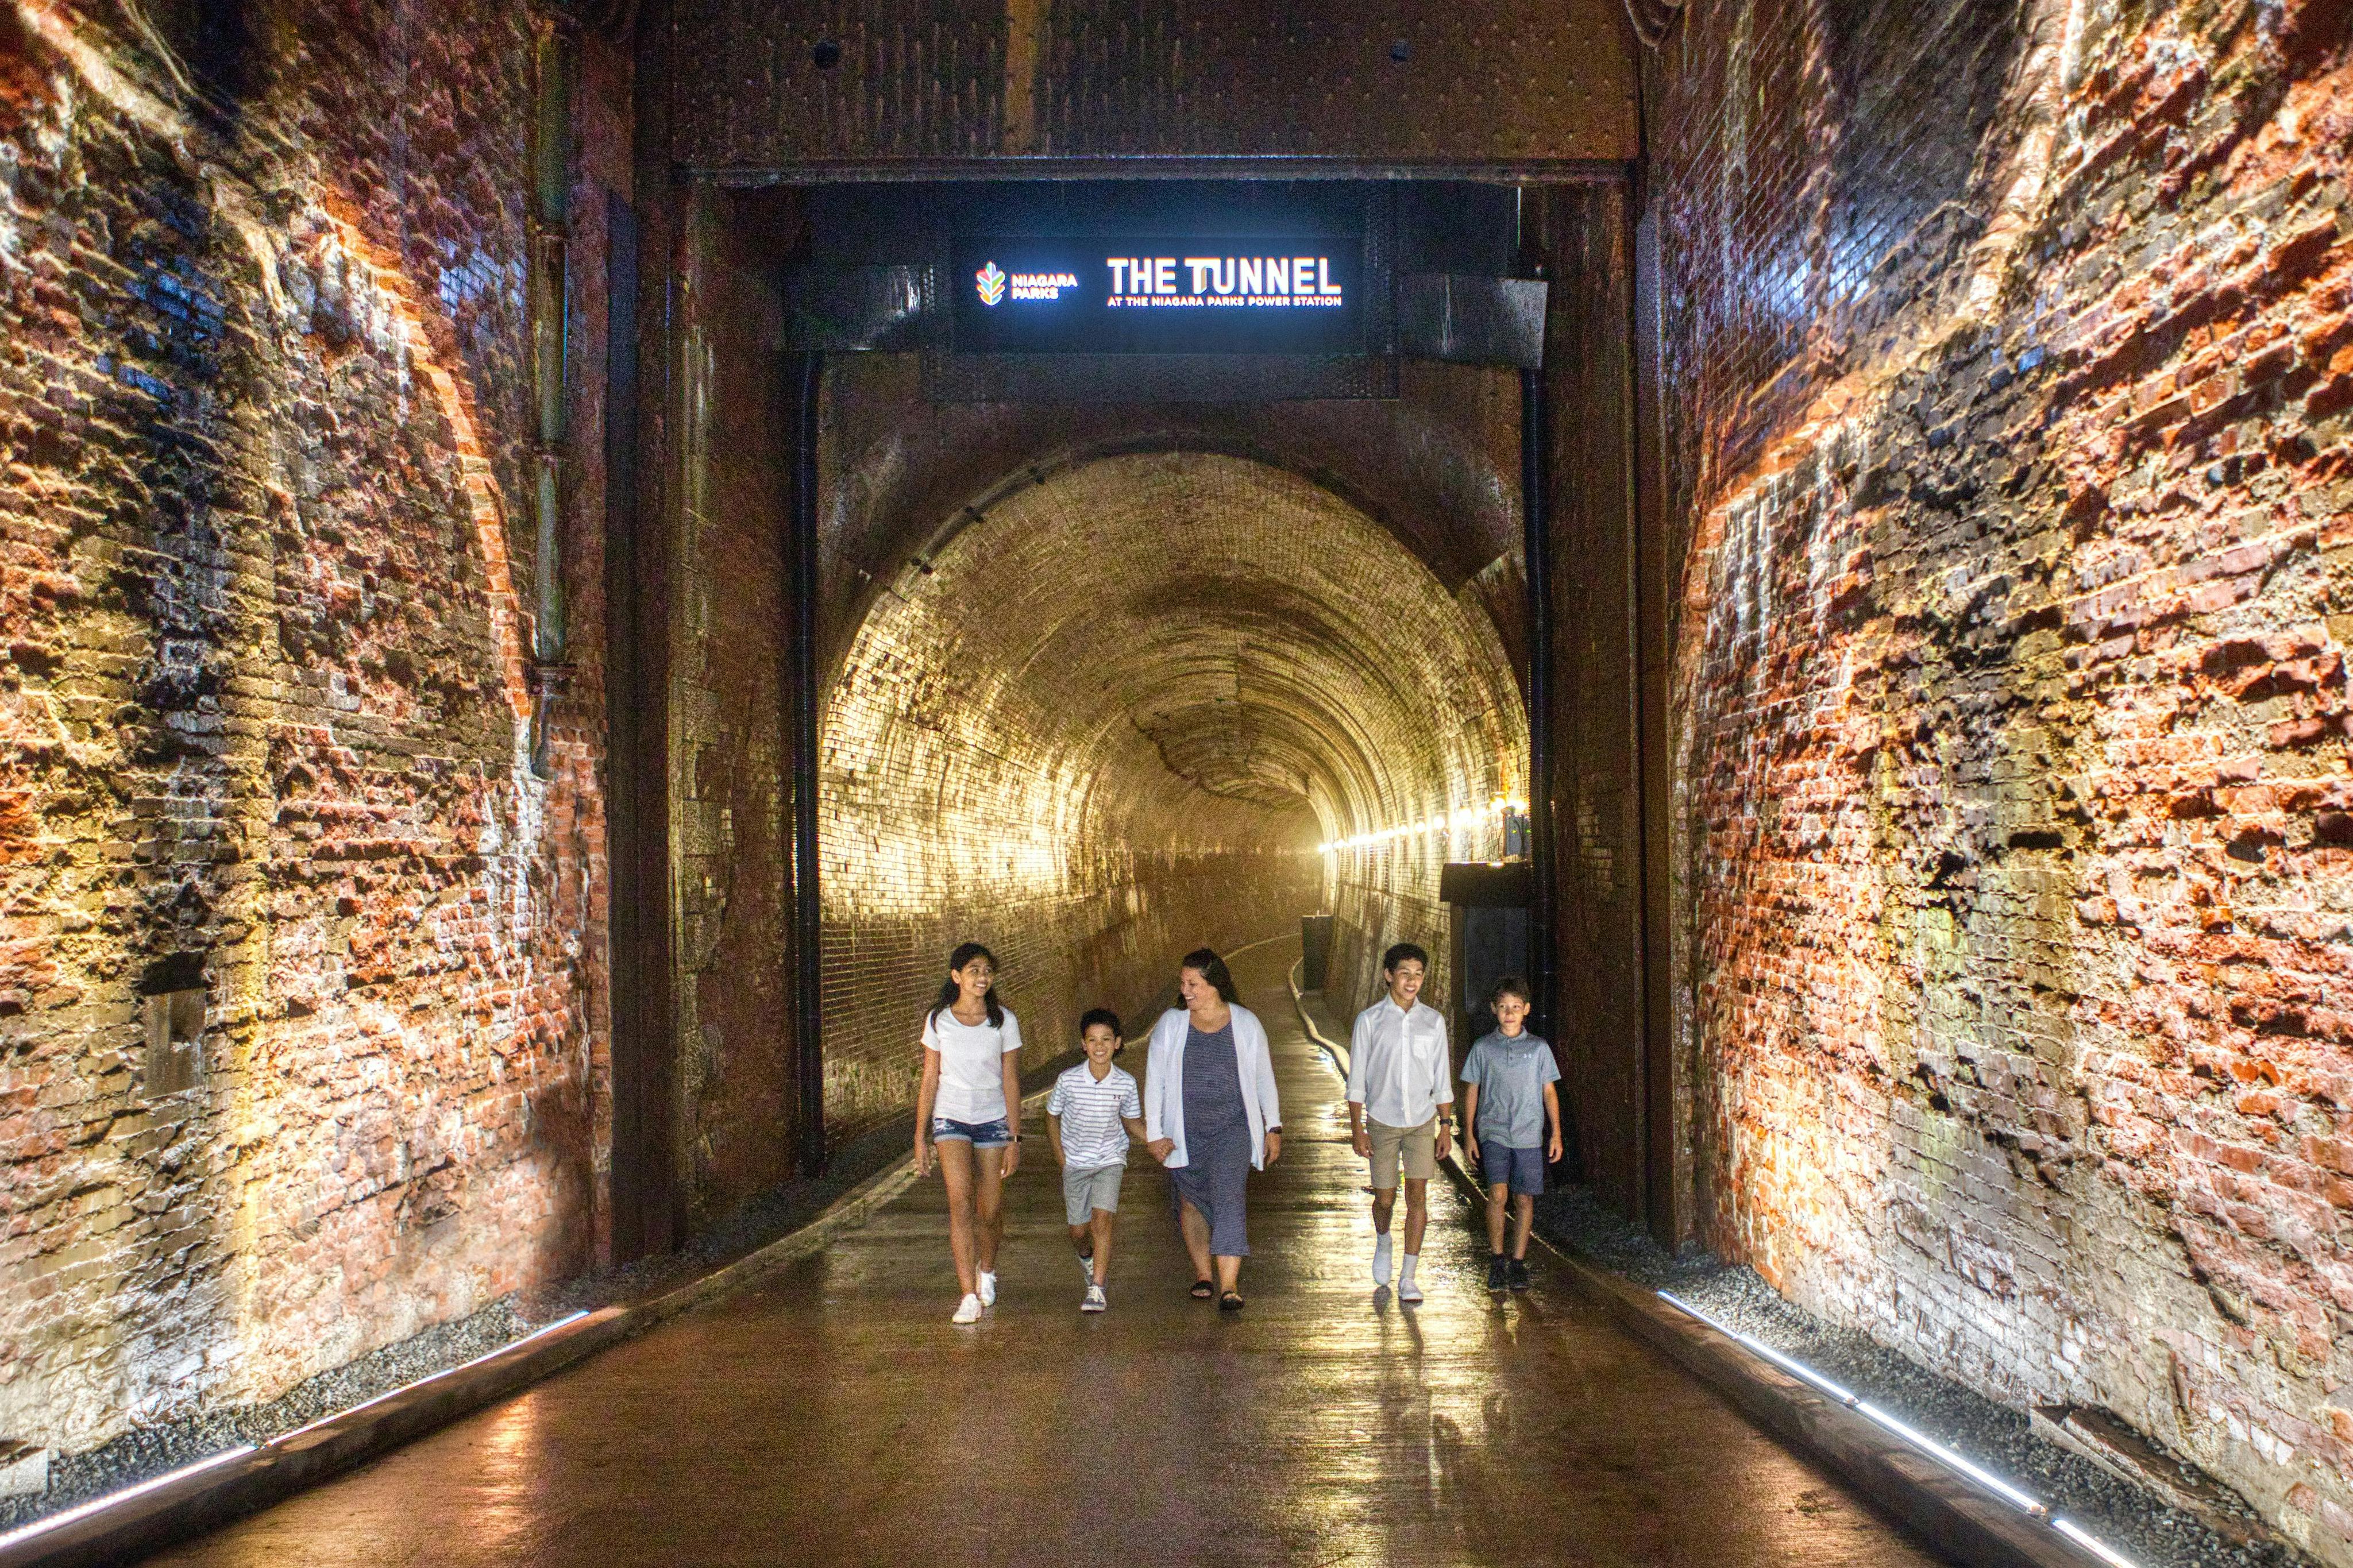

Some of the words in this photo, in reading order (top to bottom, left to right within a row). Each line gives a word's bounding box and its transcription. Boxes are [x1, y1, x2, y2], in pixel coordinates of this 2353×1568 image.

[1011, 273, 1078, 287] NIAGARA
[1107, 257, 1176, 294] THE
[1185, 257, 1341, 295] TUNNEL
[1011, 287, 1059, 299] PARKS
[1108, 296, 1123, 307] AT
[1125, 296, 1149, 307] THE
[1151, 296, 1204, 307] NIAGARA
[1207, 295, 1244, 307] PARKS
[1248, 295, 1290, 307] POWER
[1293, 295, 1342, 307] STATION
